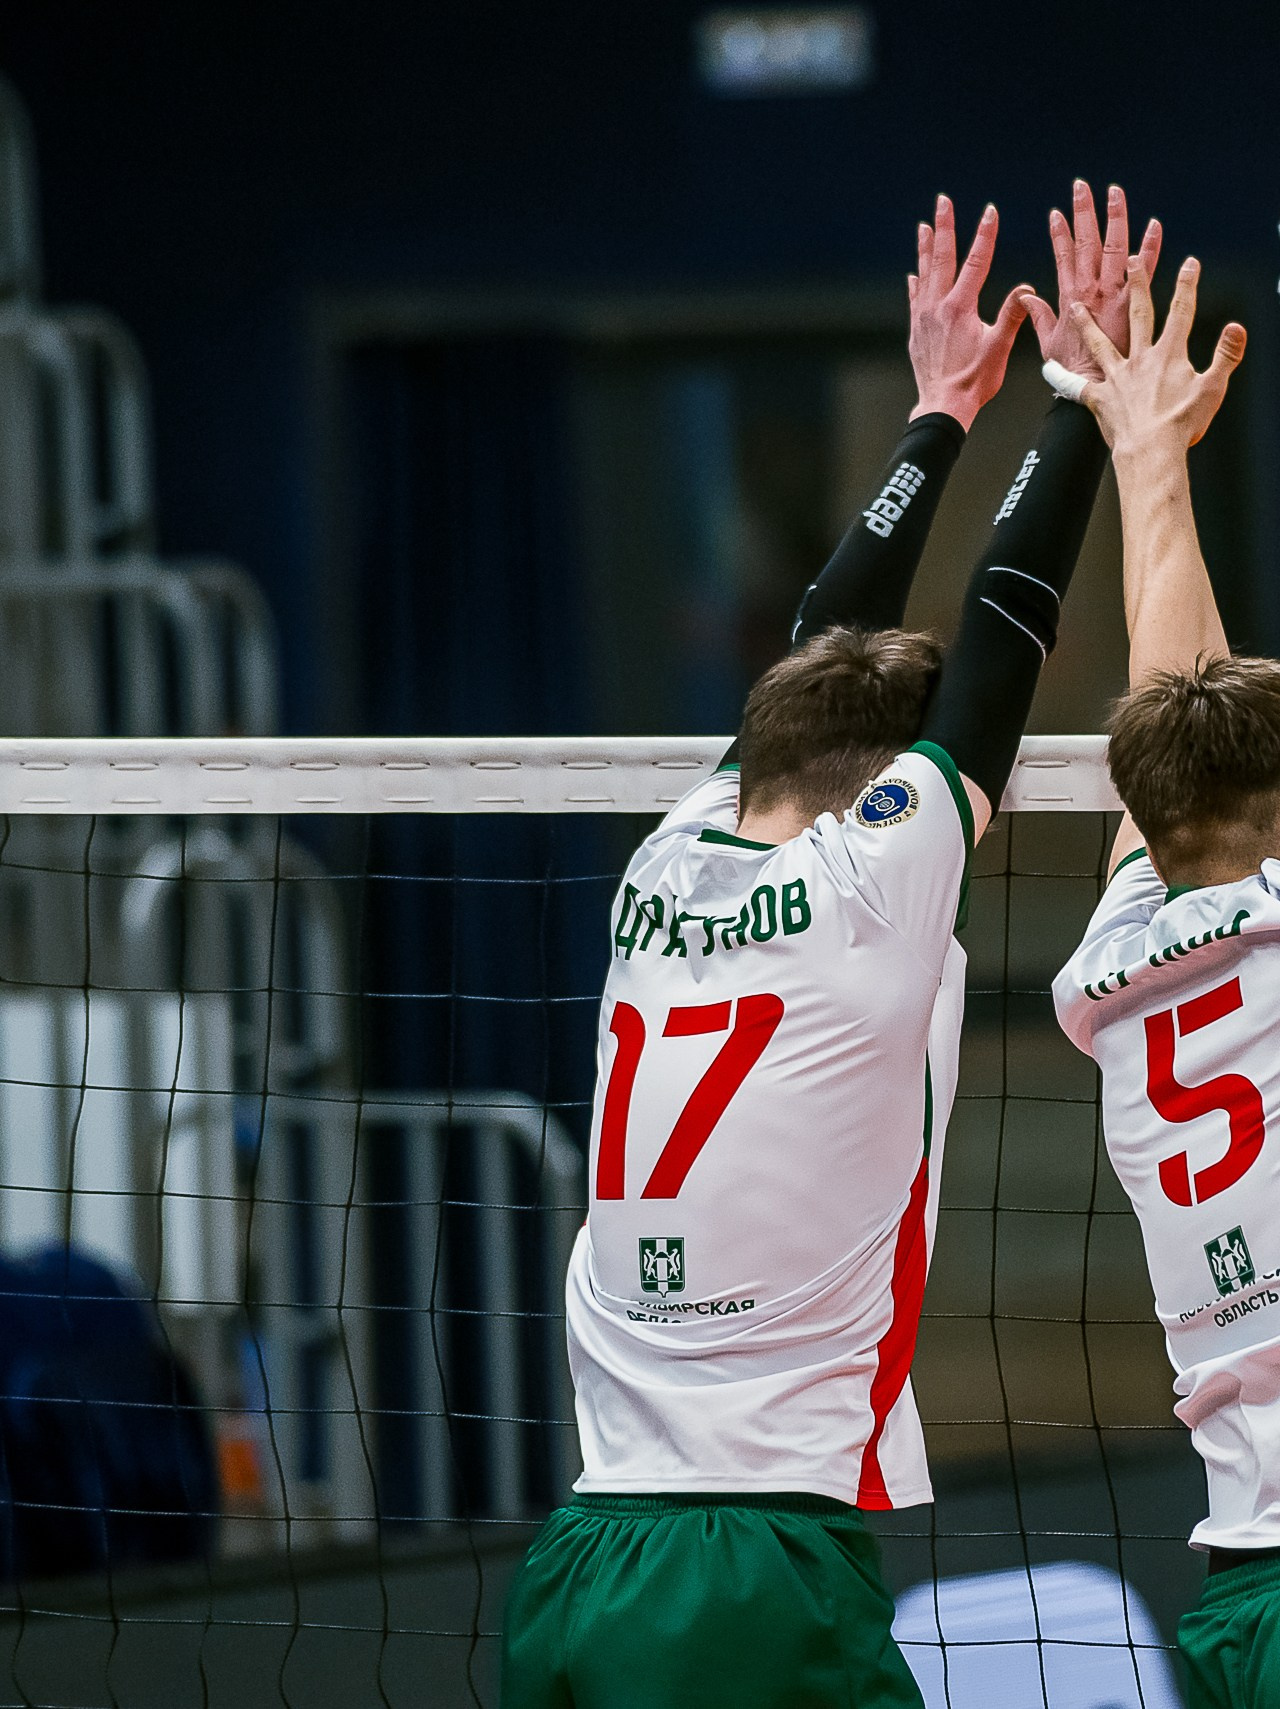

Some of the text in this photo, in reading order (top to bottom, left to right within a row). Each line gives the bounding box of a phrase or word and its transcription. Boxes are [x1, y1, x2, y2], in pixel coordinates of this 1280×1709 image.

[596, 993, 785, 1200] 17
[1143, 976, 1266, 1207] 5
[1213, 1289, 1280, 1328] ОБЛАСТЬ
